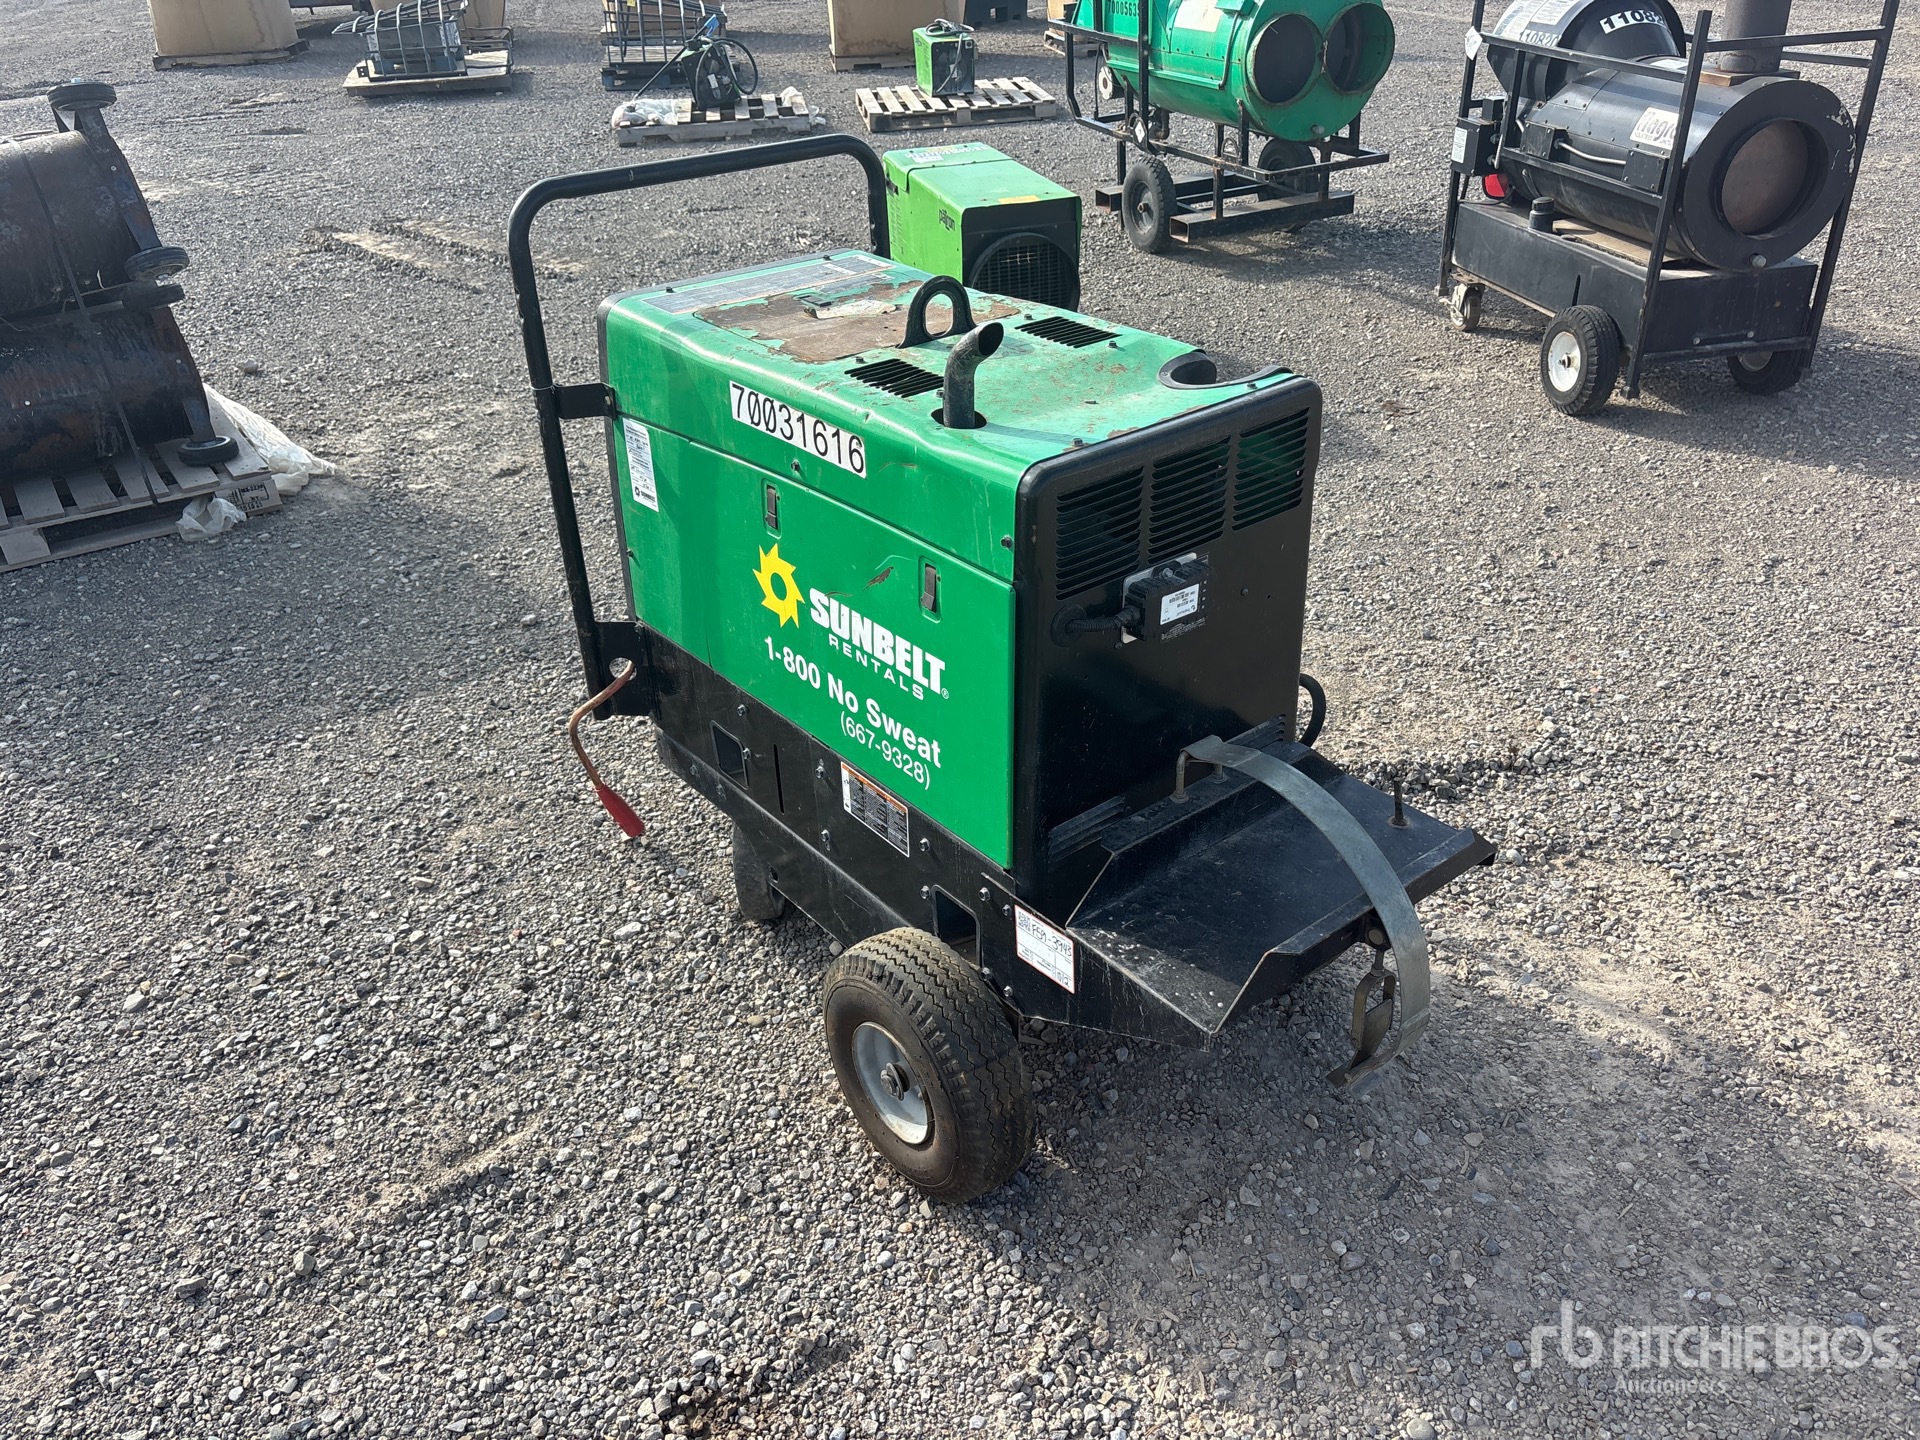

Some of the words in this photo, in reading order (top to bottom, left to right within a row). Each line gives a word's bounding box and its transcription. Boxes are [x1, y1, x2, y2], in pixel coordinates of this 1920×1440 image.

[731, 382, 865, 474] 70031616
[809, 587, 946, 695] SUNBELT
[828, 633, 924, 701] RENTALS
[764, 635, 821, 690] 1-800
[827, 671, 859, 714] No
[865, 698, 942, 769] Sweat
[840, 710, 931, 791] (667-9328)
